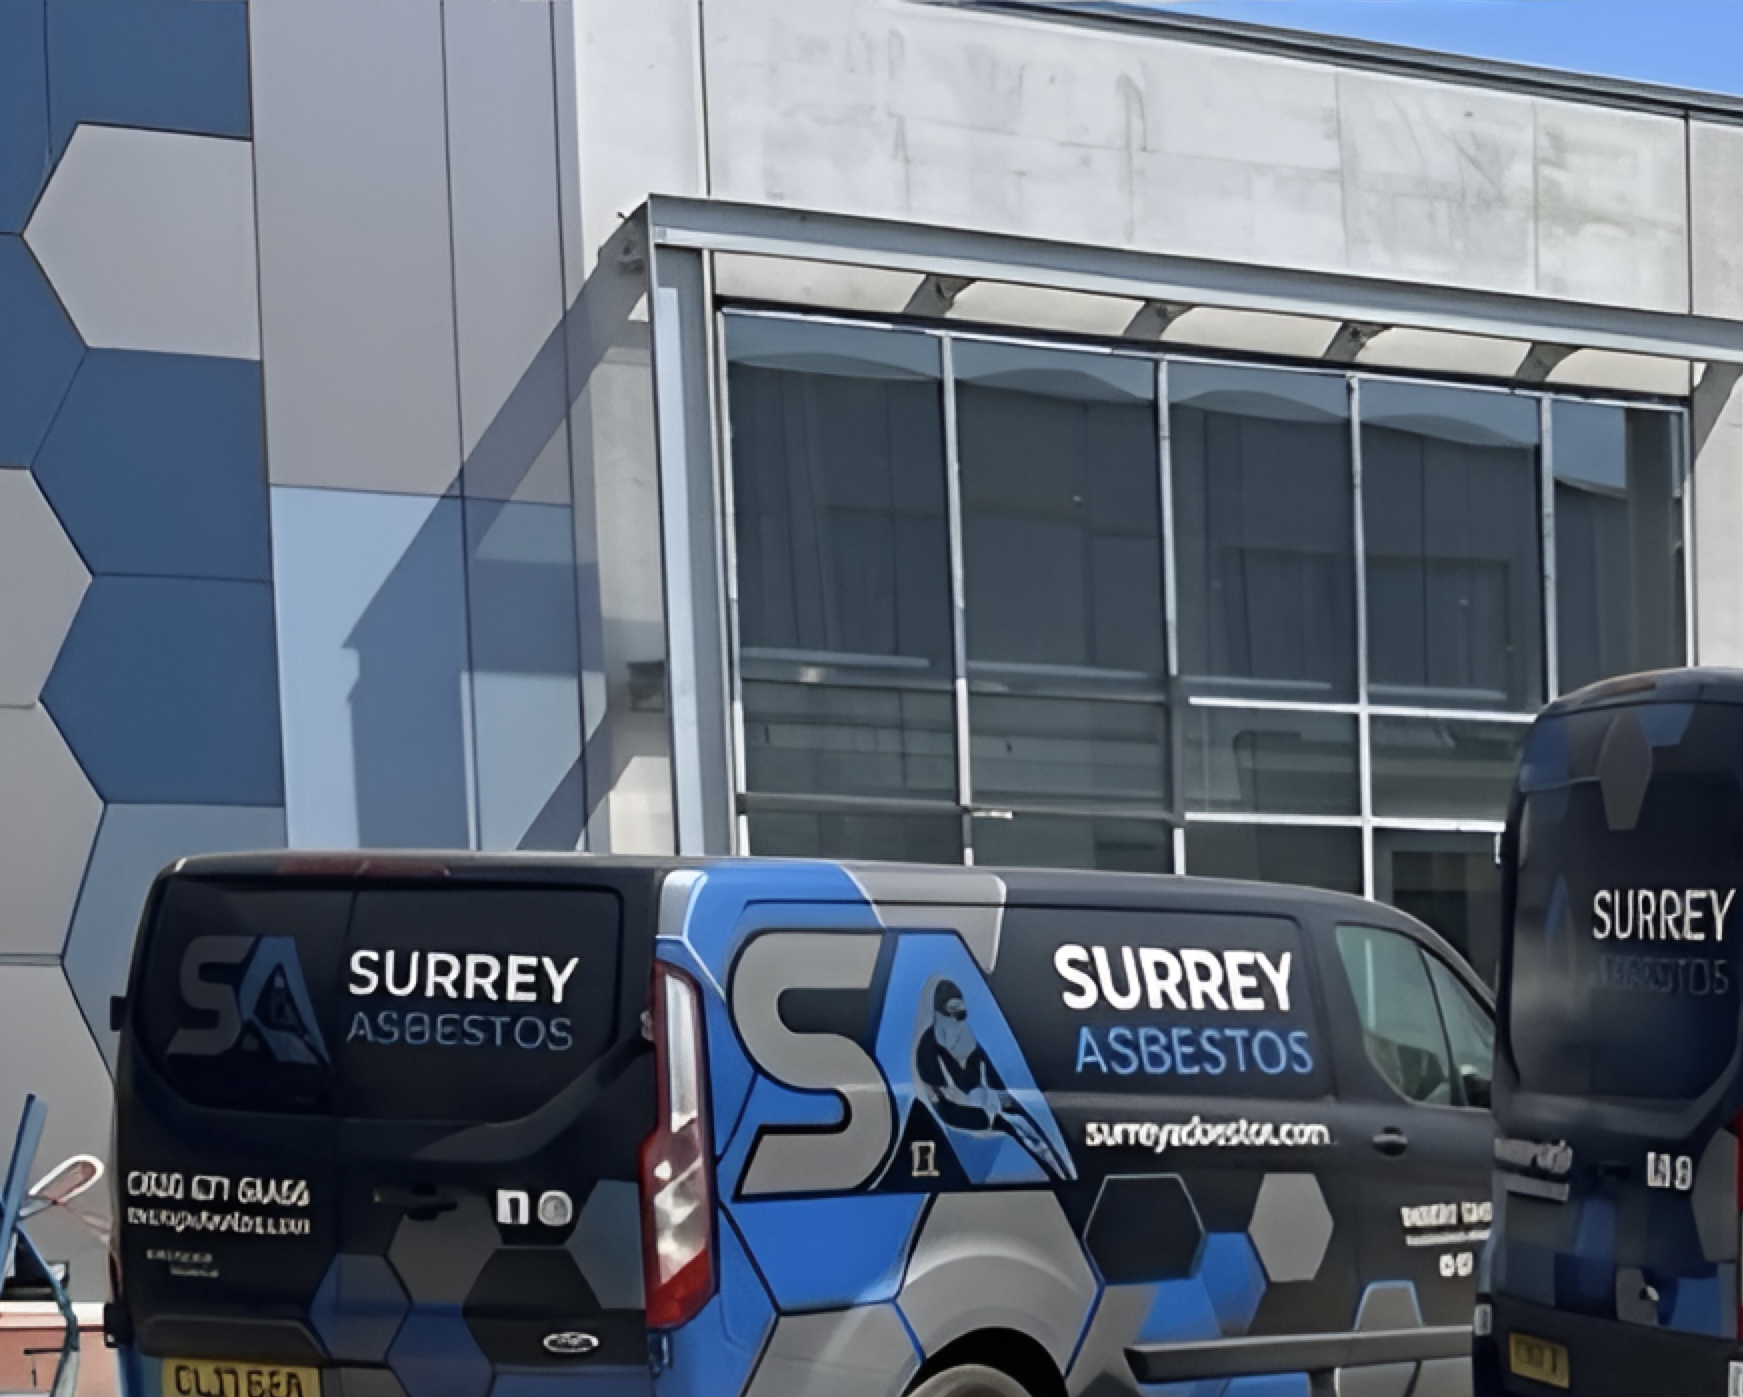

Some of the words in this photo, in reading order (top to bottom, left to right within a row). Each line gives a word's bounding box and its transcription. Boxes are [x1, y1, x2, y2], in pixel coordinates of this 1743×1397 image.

[1592, 888, 1737, 942] SURREY
[349, 949, 580, 1004] SURREY
[1054, 942, 1293, 1012] SURREY
[347, 1009, 575, 1052] ASBESTOS
[1075, 1024, 1315, 1076] ASBESTOS
